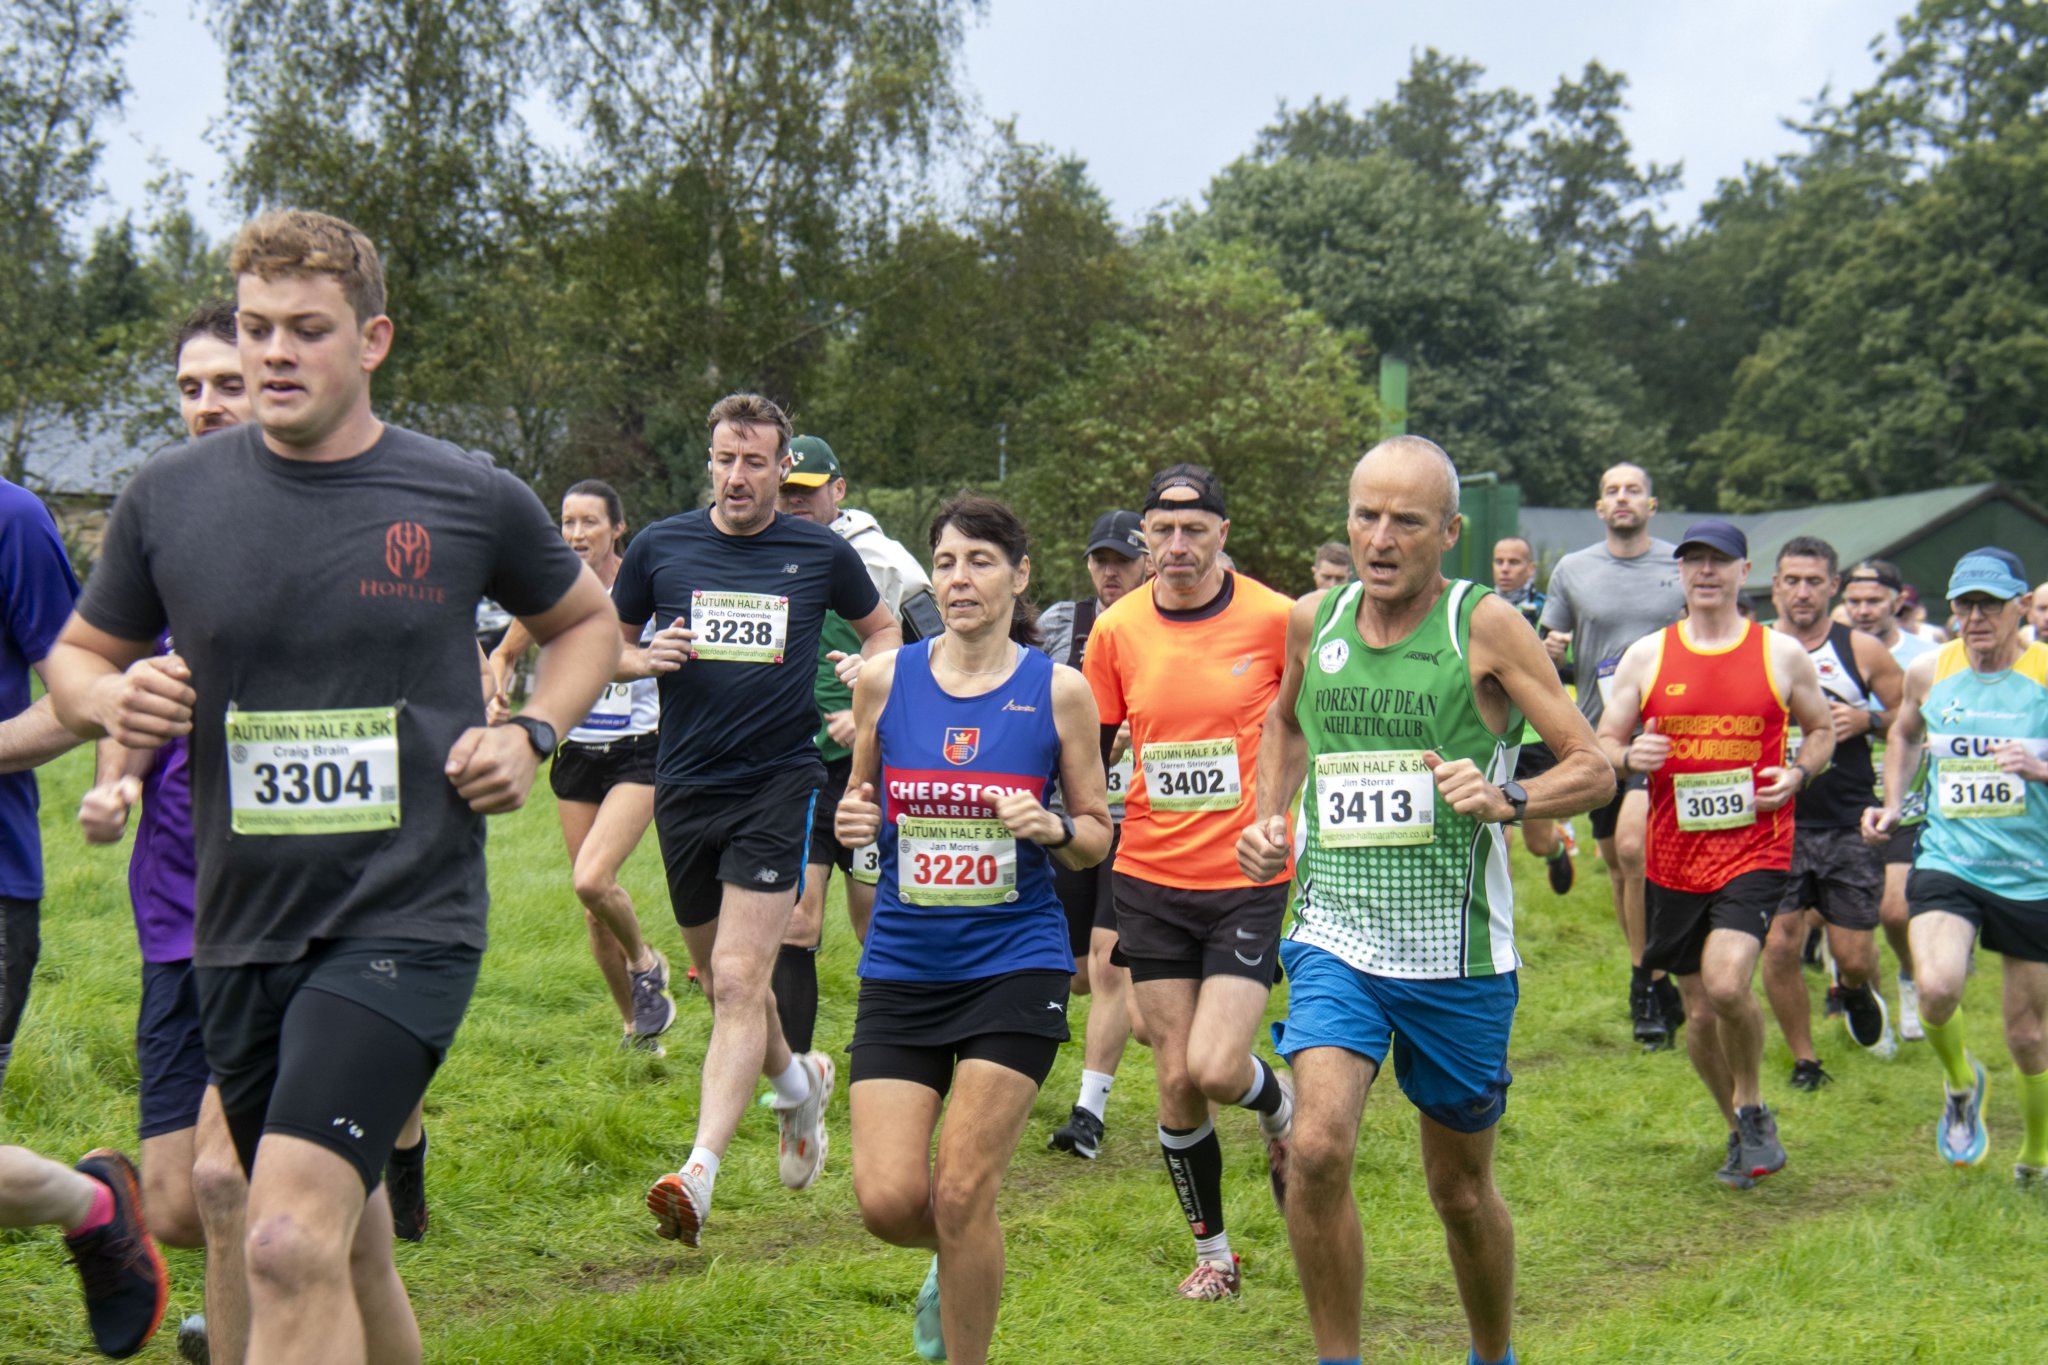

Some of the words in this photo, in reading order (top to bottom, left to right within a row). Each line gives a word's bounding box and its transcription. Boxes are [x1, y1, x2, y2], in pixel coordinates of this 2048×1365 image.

[360, 578, 446, 604] HOPLITE
[694, 596, 735, 608] AUTUMN
[737, 599, 762, 609] HALF
[764, 600, 771, 610] &
[773, 602, 786, 611] 5K
[708, 609, 725, 618] Rich
[727, 610, 772, 620] Crowcombe
[704, 618, 773, 646] 3238
[1315, 686, 1370, 713] FOREST
[1370, 688, 1394, 714] OF
[1393, 688, 1439, 719] DEAN
[232, 723, 300, 741] AUTUMN
[305, 722, 349, 740] HALF
[354, 722, 366, 738] &
[371, 720, 392, 737] 5K
[1323, 715, 1385, 737] ATHLETIC
[1386, 718, 1423, 738] CLUB
[1657, 715, 1766, 736] HEREFORD
[272, 745, 310, 760] Craig
[313, 745, 350, 757] Brain
[1142, 749, 1182, 761] AUTUMN
[1184, 747, 1209, 759] HALF
[1211, 746, 1219, 756] &
[1221, 744, 1235, 755] 5K
[1950, 736, 2012, 758] GU
[1160, 761, 1186, 770] Darren
[1186, 760, 1218, 769] Stringer
[1317, 762, 1359, 776] AUTUMN
[1363, 760, 1396, 773] HALF
[1399, 760, 1408, 772] &
[1411, 759, 1428, 772] 5K
[253, 759, 374, 805] 3304
[1158, 769, 1225, 796] 3402
[1341, 778, 1358, 788] Jim
[1360, 777, 1395, 787] Storrar
[1676, 778, 1708, 788] AUTUMN
[1709, 777, 1731, 787] HALF
[1950, 782, 2012, 804] 3146
[908, 803, 1000, 818] HARRIER
[1329, 789, 1413, 825] 3413
[1687, 794, 1744, 818] 3039
[902, 825, 947, 839] AUTUMN
[949, 826, 982, 840] HALF
[984, 827, 994, 839] &
[996, 827, 1013, 839] 5K
[930, 842, 947, 851] Jan
[949, 843, 980, 852] Morris
[913, 853, 998, 886] 3220
